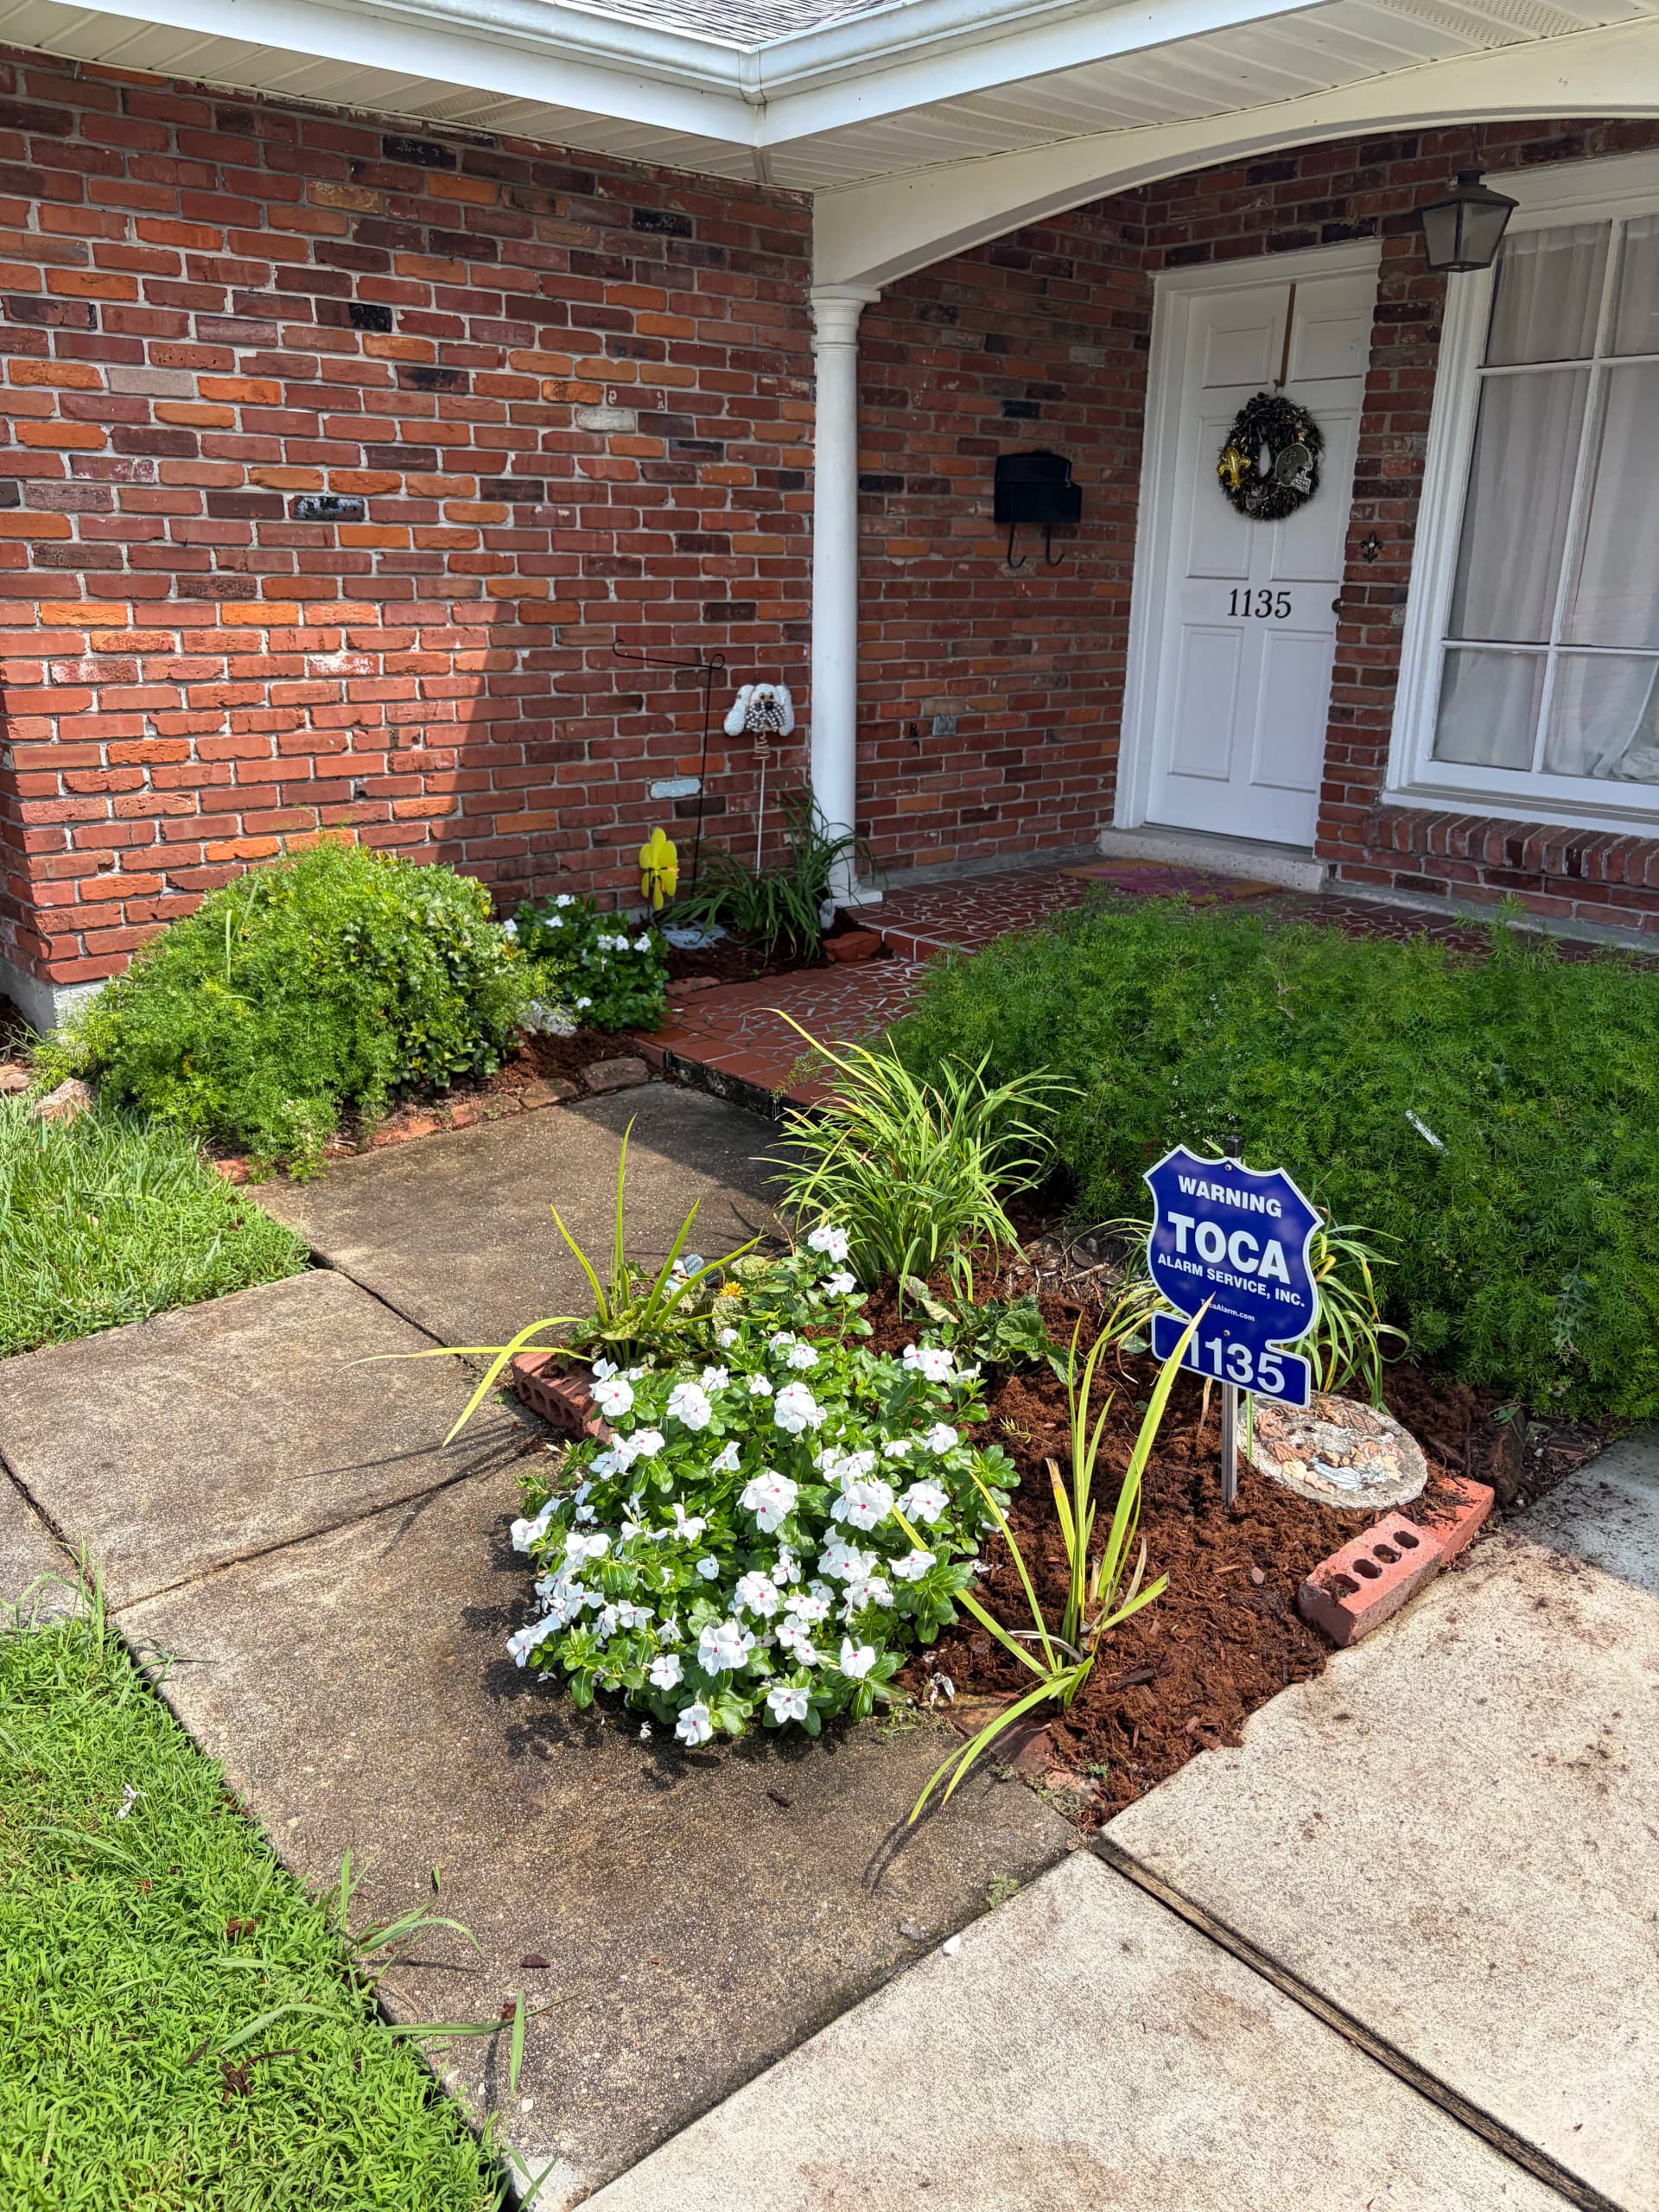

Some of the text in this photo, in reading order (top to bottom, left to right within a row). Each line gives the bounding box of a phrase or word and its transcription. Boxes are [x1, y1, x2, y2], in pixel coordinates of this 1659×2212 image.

[1228, 588, 1292, 619] 1135
[1178, 1175, 1282, 1218] WARNING
[1167, 1211, 1291, 1285] TOCA
[1158, 1253, 1306, 1307] ALARM SERVICE, INC.
[1200, 1298, 1255, 1322] TcaAlarm.com
[1189, 1331, 1286, 1394] 1135
